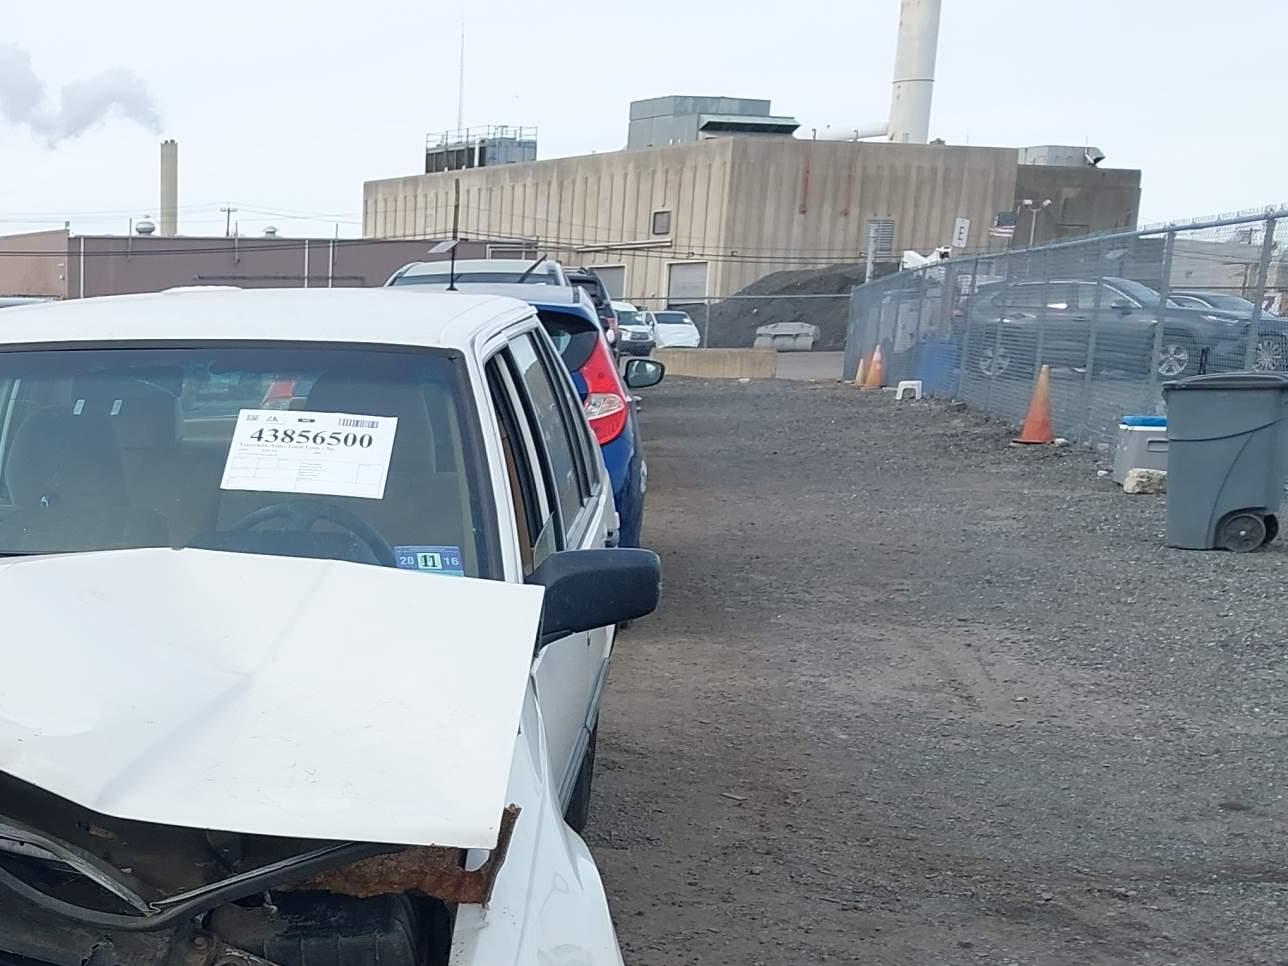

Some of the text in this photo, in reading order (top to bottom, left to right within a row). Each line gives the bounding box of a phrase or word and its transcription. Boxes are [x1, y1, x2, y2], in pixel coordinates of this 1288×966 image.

[250, 427, 373, 448] 43856500
[399, 555, 460, 567] 20 11 16
